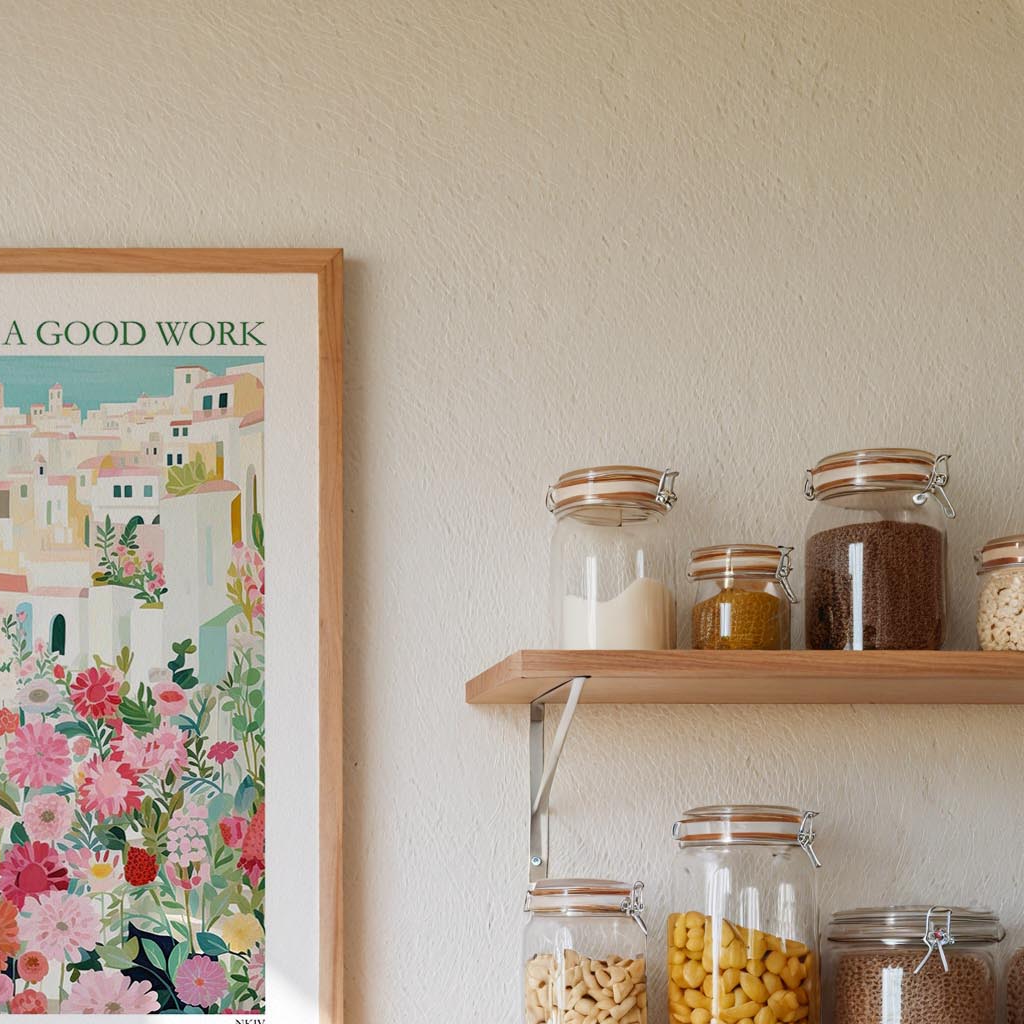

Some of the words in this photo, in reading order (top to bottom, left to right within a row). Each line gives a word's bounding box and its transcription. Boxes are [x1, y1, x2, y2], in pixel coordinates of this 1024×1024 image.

[3, 320, 26, 345] A
[36, 320, 146, 346] GOOD
[156, 321, 266, 346] WORK
